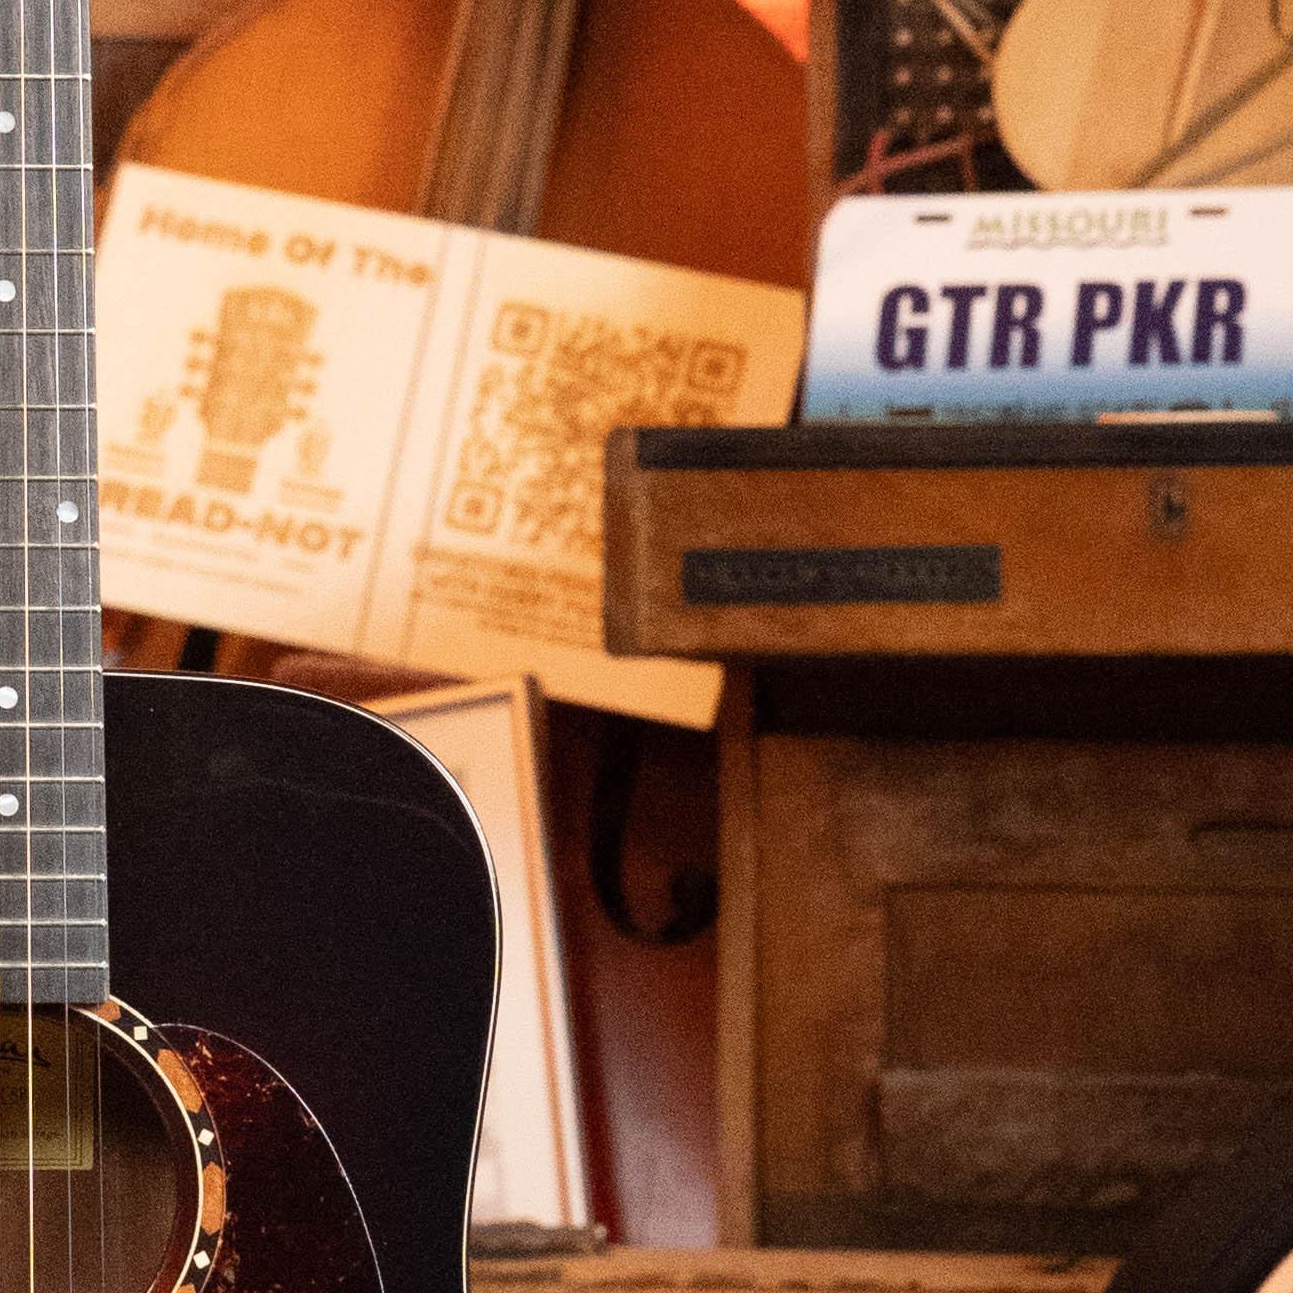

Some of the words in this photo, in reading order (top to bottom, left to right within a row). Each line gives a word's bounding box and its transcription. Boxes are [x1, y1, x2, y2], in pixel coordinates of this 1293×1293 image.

[138, 205, 269, 256] Home
[285, 231, 337, 268] Of
[353, 244, 434, 288] The
[970, 208, 1169, 240] MISSOURI
[876, 283, 1045, 372] GTR
[1070, 278, 1246, 369] PKR
